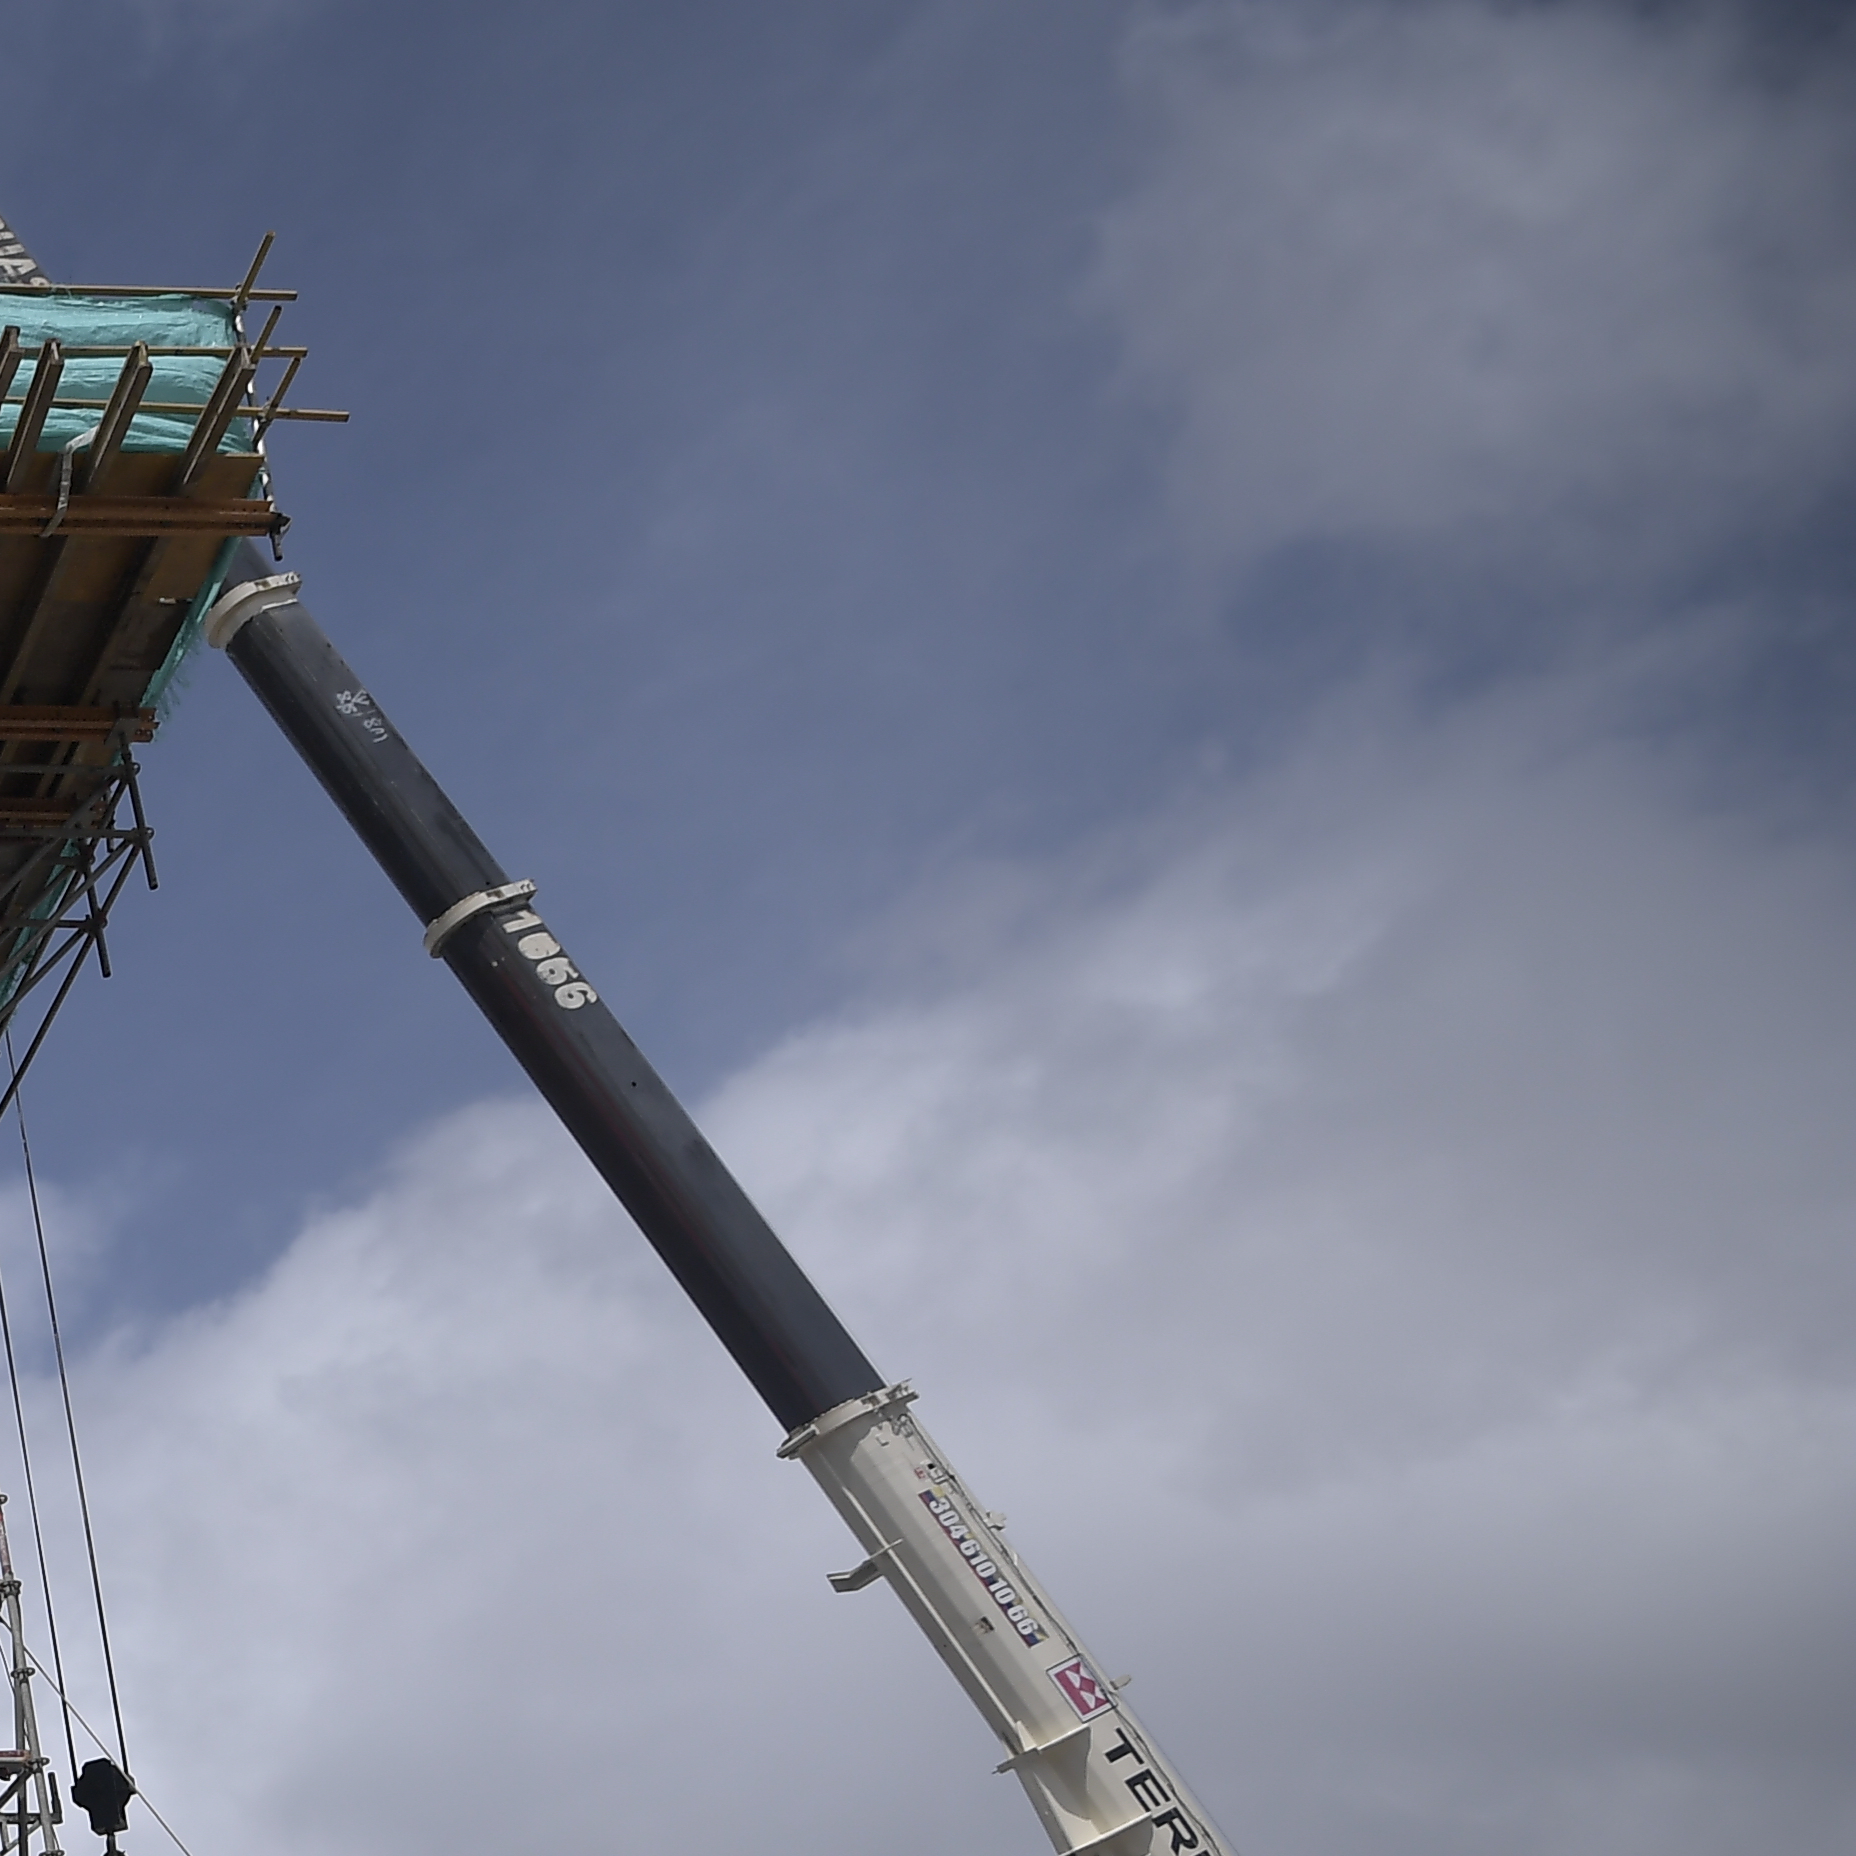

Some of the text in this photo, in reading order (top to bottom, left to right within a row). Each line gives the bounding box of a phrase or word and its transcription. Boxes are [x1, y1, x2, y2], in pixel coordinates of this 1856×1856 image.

[502, 910, 598, 1009] 1066
[928, 1496, 1038, 1636] 304 610 10 66
